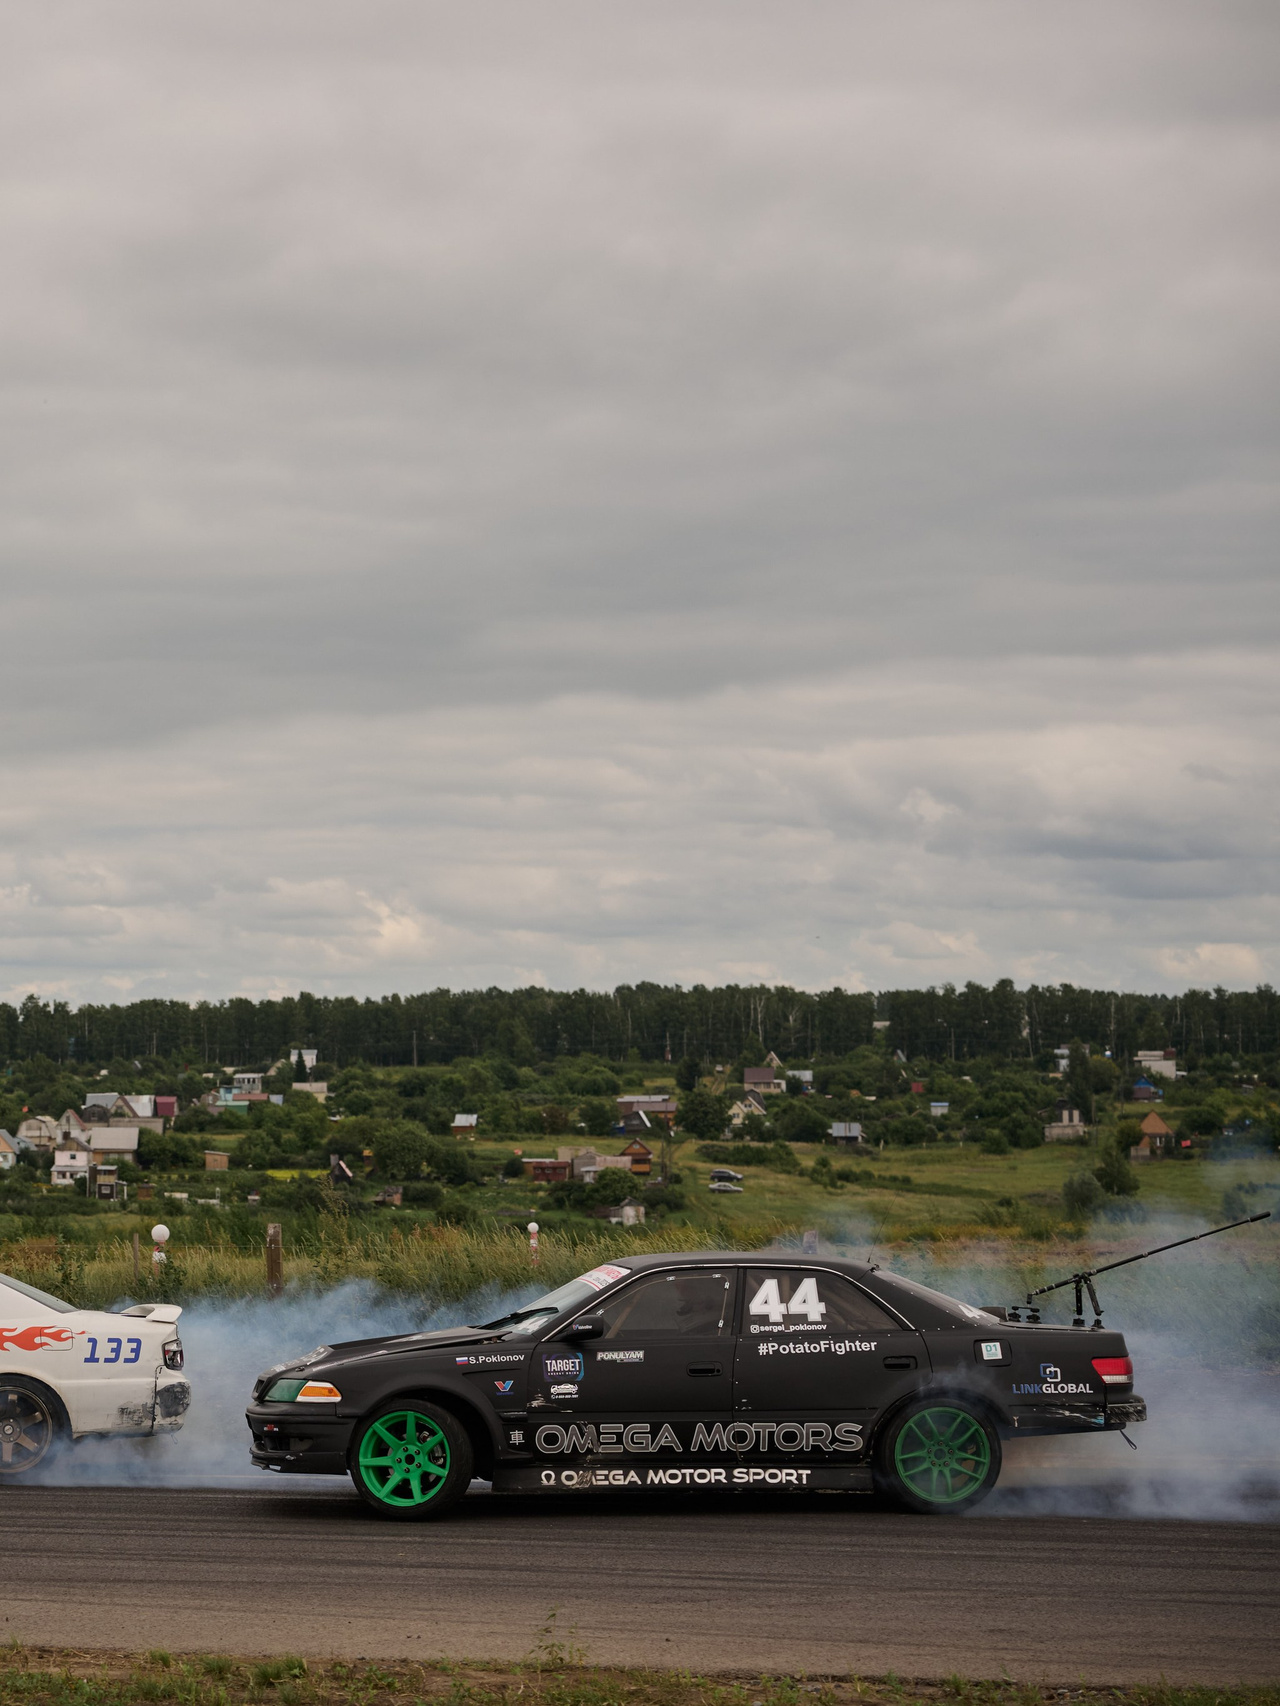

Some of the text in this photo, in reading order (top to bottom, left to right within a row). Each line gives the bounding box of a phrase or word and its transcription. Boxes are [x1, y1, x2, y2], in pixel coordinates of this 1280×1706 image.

[748, 1277, 827, 1322] 44
[83, 1337, 143, 1363] 133
[597, 1351, 643, 1360] PONULYAM
[758, 1340, 877, 1356] #PotatoFighter
[985, 1344, 998, 1352] D1
[468, 1354, 525, 1364] S.Poklonov
[545, 1359, 580, 1372] TARGET
[535, 1422, 864, 1454] OMEGA MOTORS
[646, 1468, 728, 1485] MOTOR
[732, 1467, 812, 1485] SPORT
